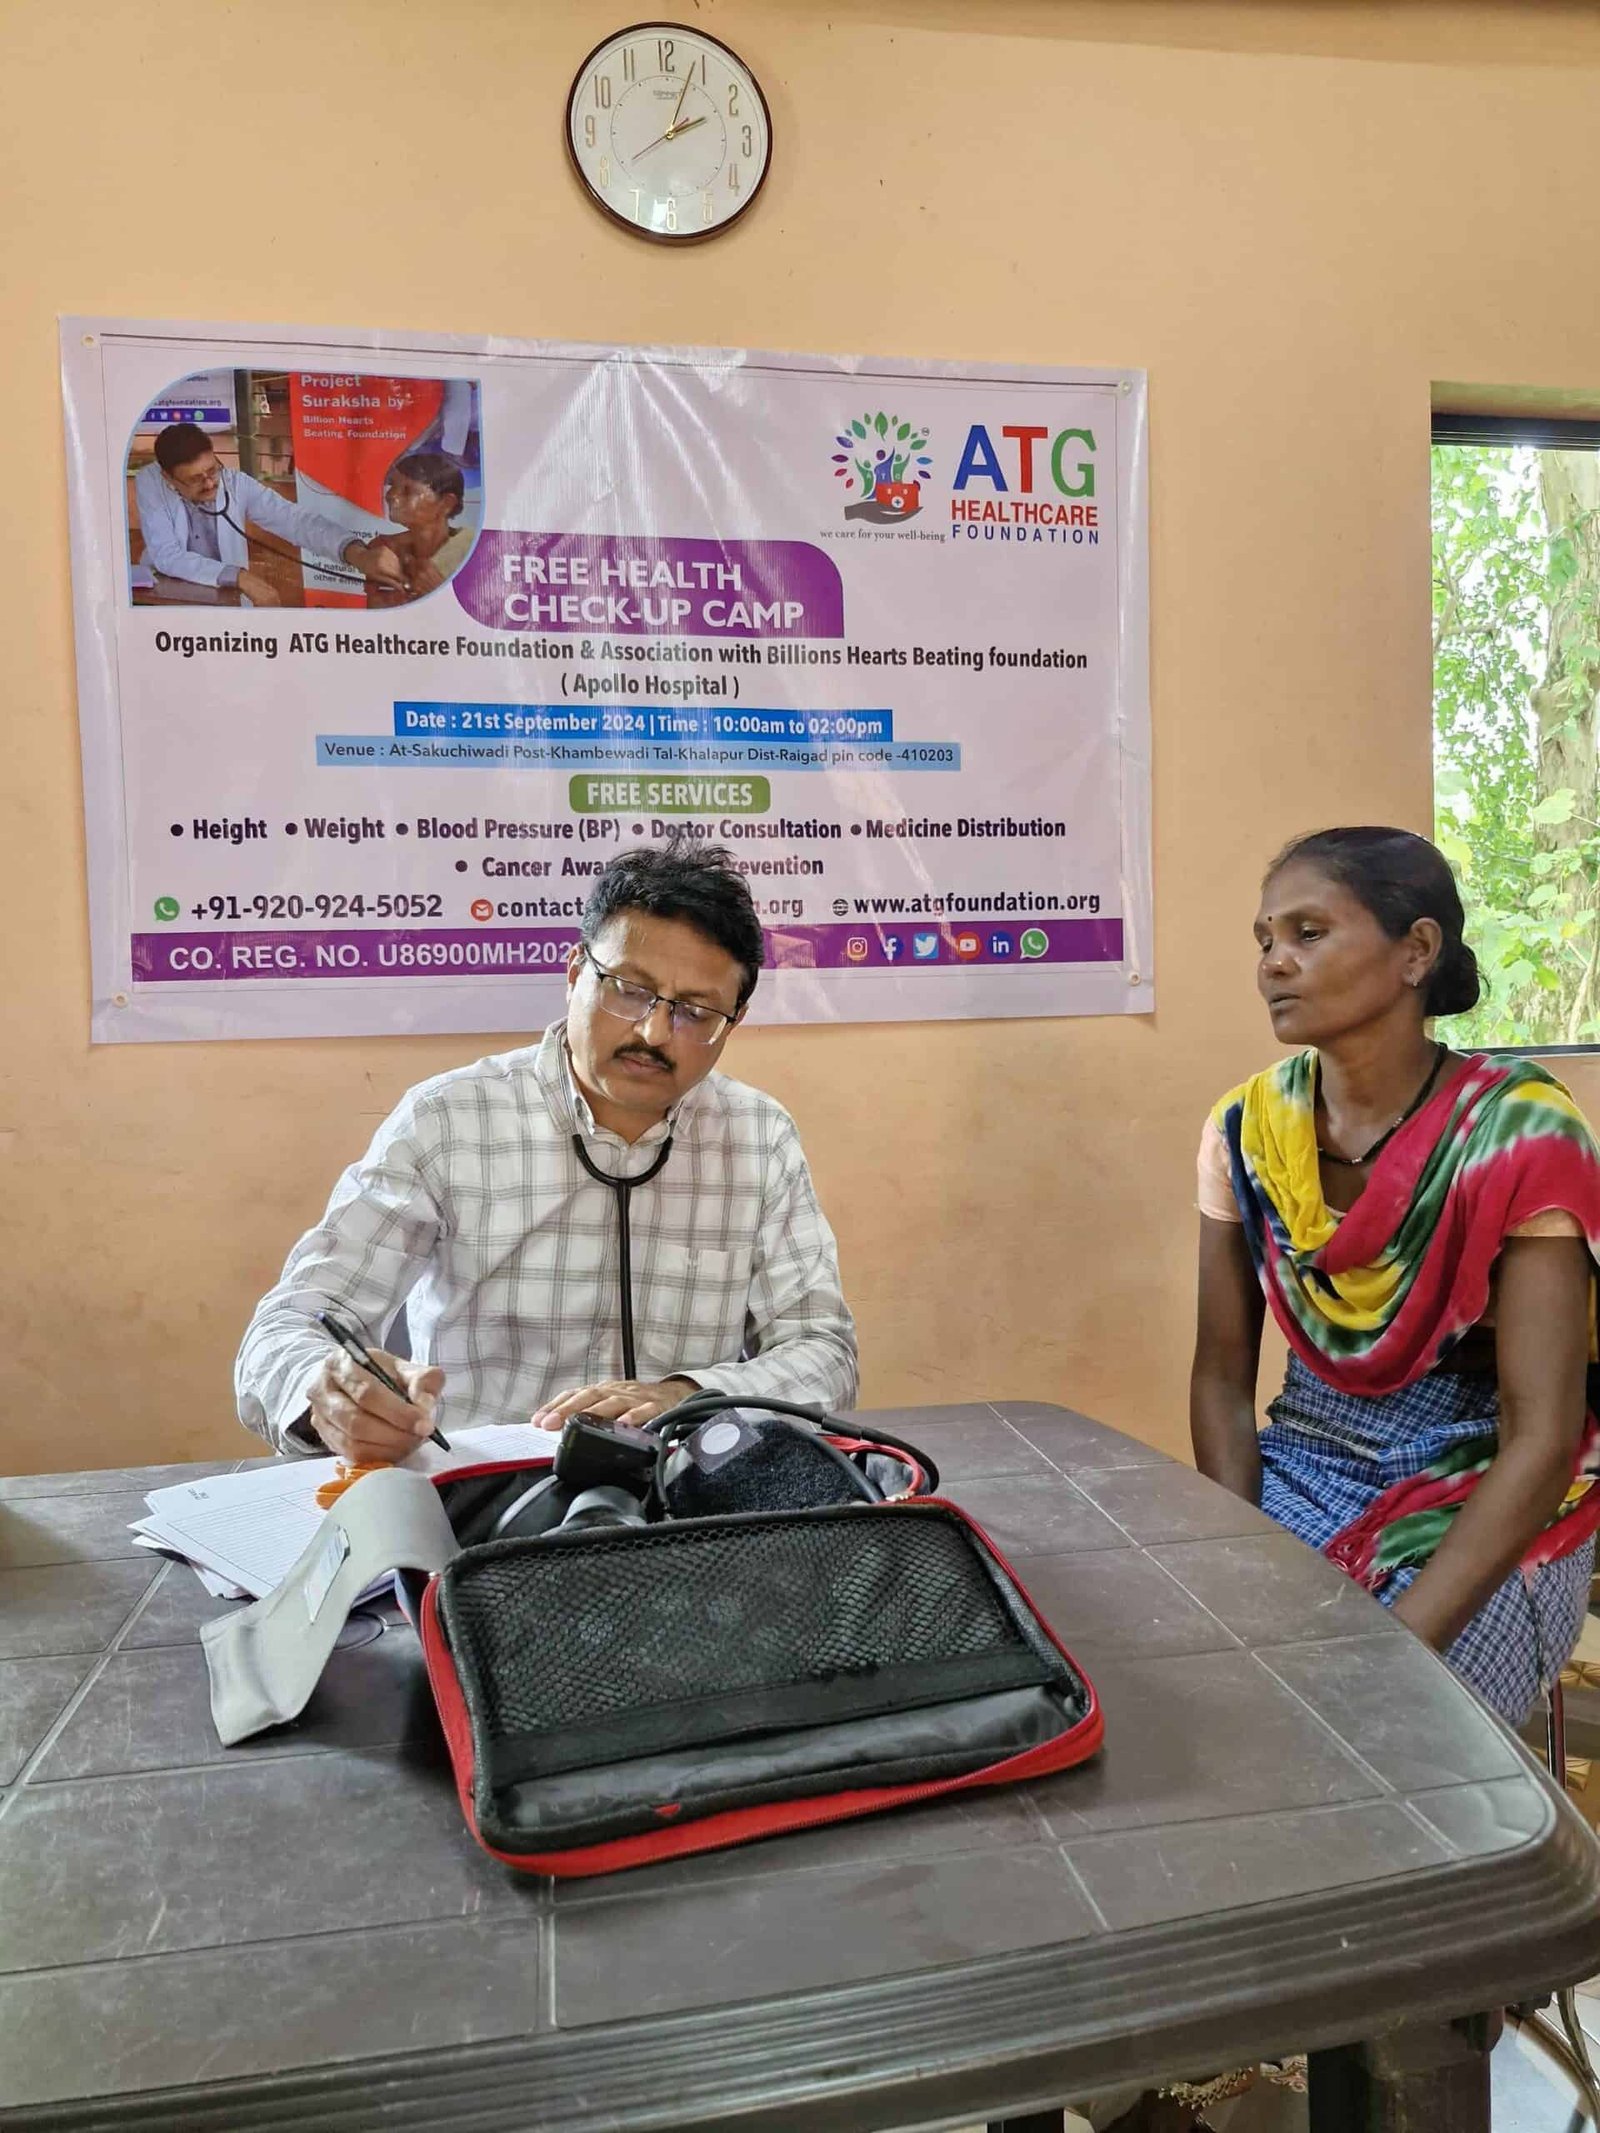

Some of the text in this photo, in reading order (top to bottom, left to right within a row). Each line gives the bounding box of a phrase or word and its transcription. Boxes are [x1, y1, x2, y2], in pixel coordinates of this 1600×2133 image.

[623, 48, 635, 82] 11
[658, 40, 675, 72] 12
[702, 54, 706, 85] 1
[595, 75, 611, 109] 10
[729, 84, 739, 117] 2
[585, 115, 596, 148] 9
[742, 125, 752, 158] 3
[599, 155, 611, 189] 8
[728, 163, 741, 196] 4
[630, 189, 640, 222] 7
[666, 198, 677, 231] 6
[703, 190, 713, 224] 5
[301, 374, 361, 389] Project
[302, 394, 405, 411] Suraksha by
[302, 415, 375, 425] Billion Hearts
[303, 429, 406, 440] Beating Foundation
[953, 425, 1097, 498] ATG
[951, 499, 1098, 527] HEALTHCARE
[858, 528, 871, 539] for
[871, 532, 895, 542] your
[897, 529, 946, 543] well-being
[952, 524, 1099, 545] FOUNDATION
[502, 555, 742, 591] FREE HEALTH
[503, 594, 805, 630] CHECK-UP CAMP
[155, 631, 1088, 671] Organizing ATG Healthcare Foundation & Association with Billions Hearts Beating foundation
[573, 673, 639, 699] Apollo
[646, 674, 727, 700] Hospital
[406, 710, 446, 728] Date
[462, 712, 500, 730] 21st
[504, 713, 597, 734] September
[602, 714, 645, 731] 2024
[658, 715, 697, 732] Time
[714, 716, 785, 735] 10:00am
[788, 719, 805, 734] to
[808, 718, 883, 742] 02:00pm
[325, 742, 375, 757] Venue
[389, 743, 509, 758] At-Sakuchiwadi
[514, 745, 649, 760] Post-Khambewadi
[652, 748, 744, 765] Tal-Khalapur
[748, 748, 827, 766] Dist-Raigad
[832, 749, 853, 765] pin
[859, 750, 893, 762] code
[896, 750, 954, 763] -410203
[587, 782, 753, 806] FREE SERVICES
[193, 818, 268, 845] Height
[304, 817, 385, 844] Weight
[417, 817, 621, 842] Blood Pressure (BP)
[651, 818, 842, 839] Doctor Consultation
[866, 817, 1066, 838] Medicine Distribution
[482, 857, 551, 877] Cancer
[727, 855, 824, 875] revention
[191, 894, 443, 921] +91-920-924-5052
[497, 896, 584, 917] contact
[854, 891, 1101, 916] www.atgfoundation.org
[169, 939, 572, 970] CO. REG. NO. U86900MH202
